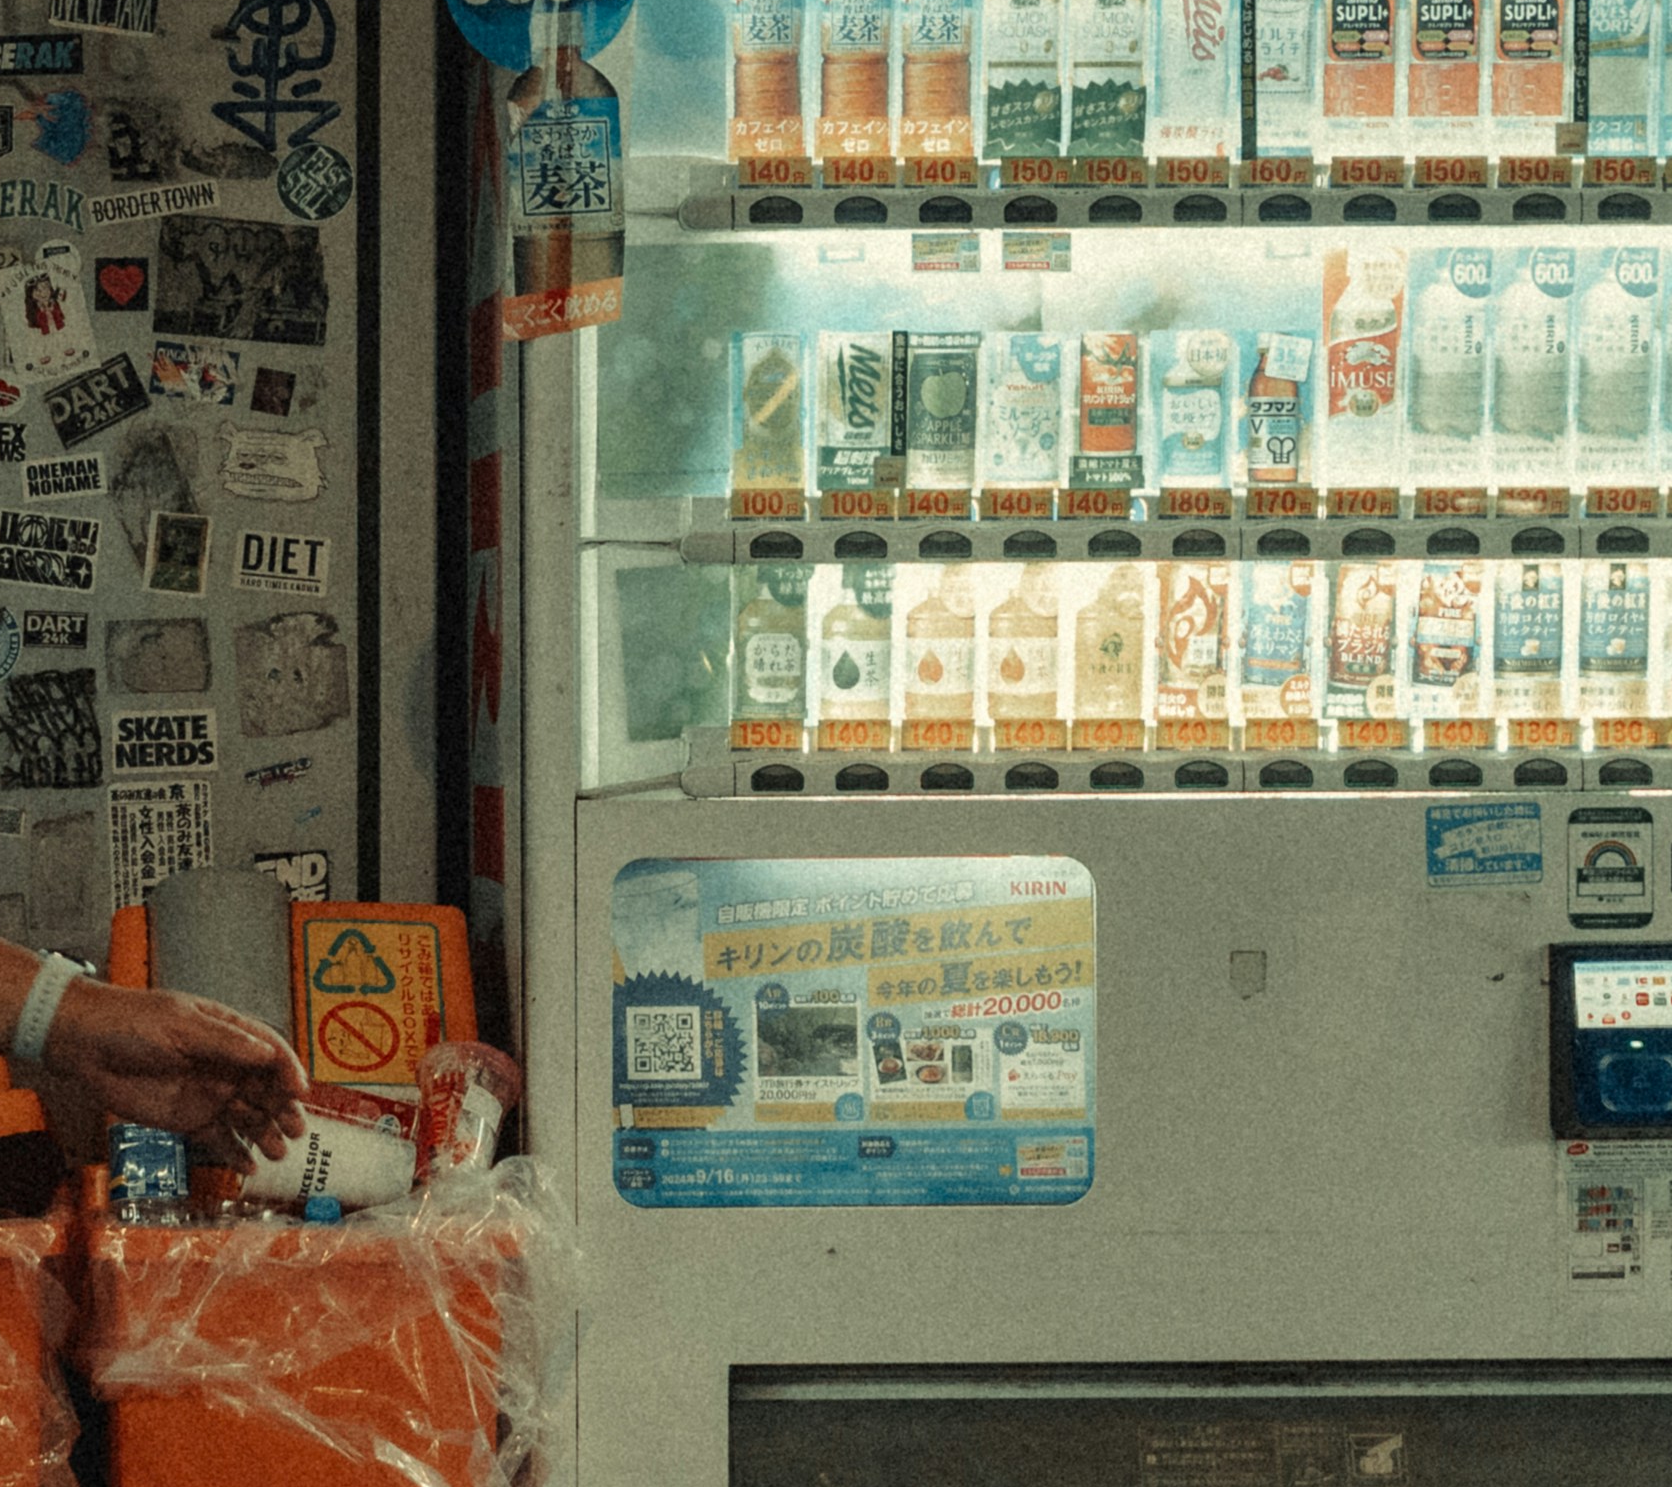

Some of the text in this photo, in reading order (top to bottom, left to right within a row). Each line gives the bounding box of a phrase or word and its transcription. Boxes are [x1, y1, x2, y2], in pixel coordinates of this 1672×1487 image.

[526, 162, 609, 211] 麦茶
[49, 361, 133, 425] DART
[26, 459, 100, 480] ONEMAN
[28, 475, 102, 496] NONAME
[242, 533, 324, 576] DIET
[25, 614, 86, 633] DART
[42, 631, 71, 644] 24K
[117, 717, 208, 741] SKATE
[115, 741, 214, 767] NERDS
[1010, 880, 1068, 896] KIRIN
[715, 916, 1032, 970] キリンの炭酸を飲んで
[875, 958, 1082, 1000] 今年の夏を楽しもう!
